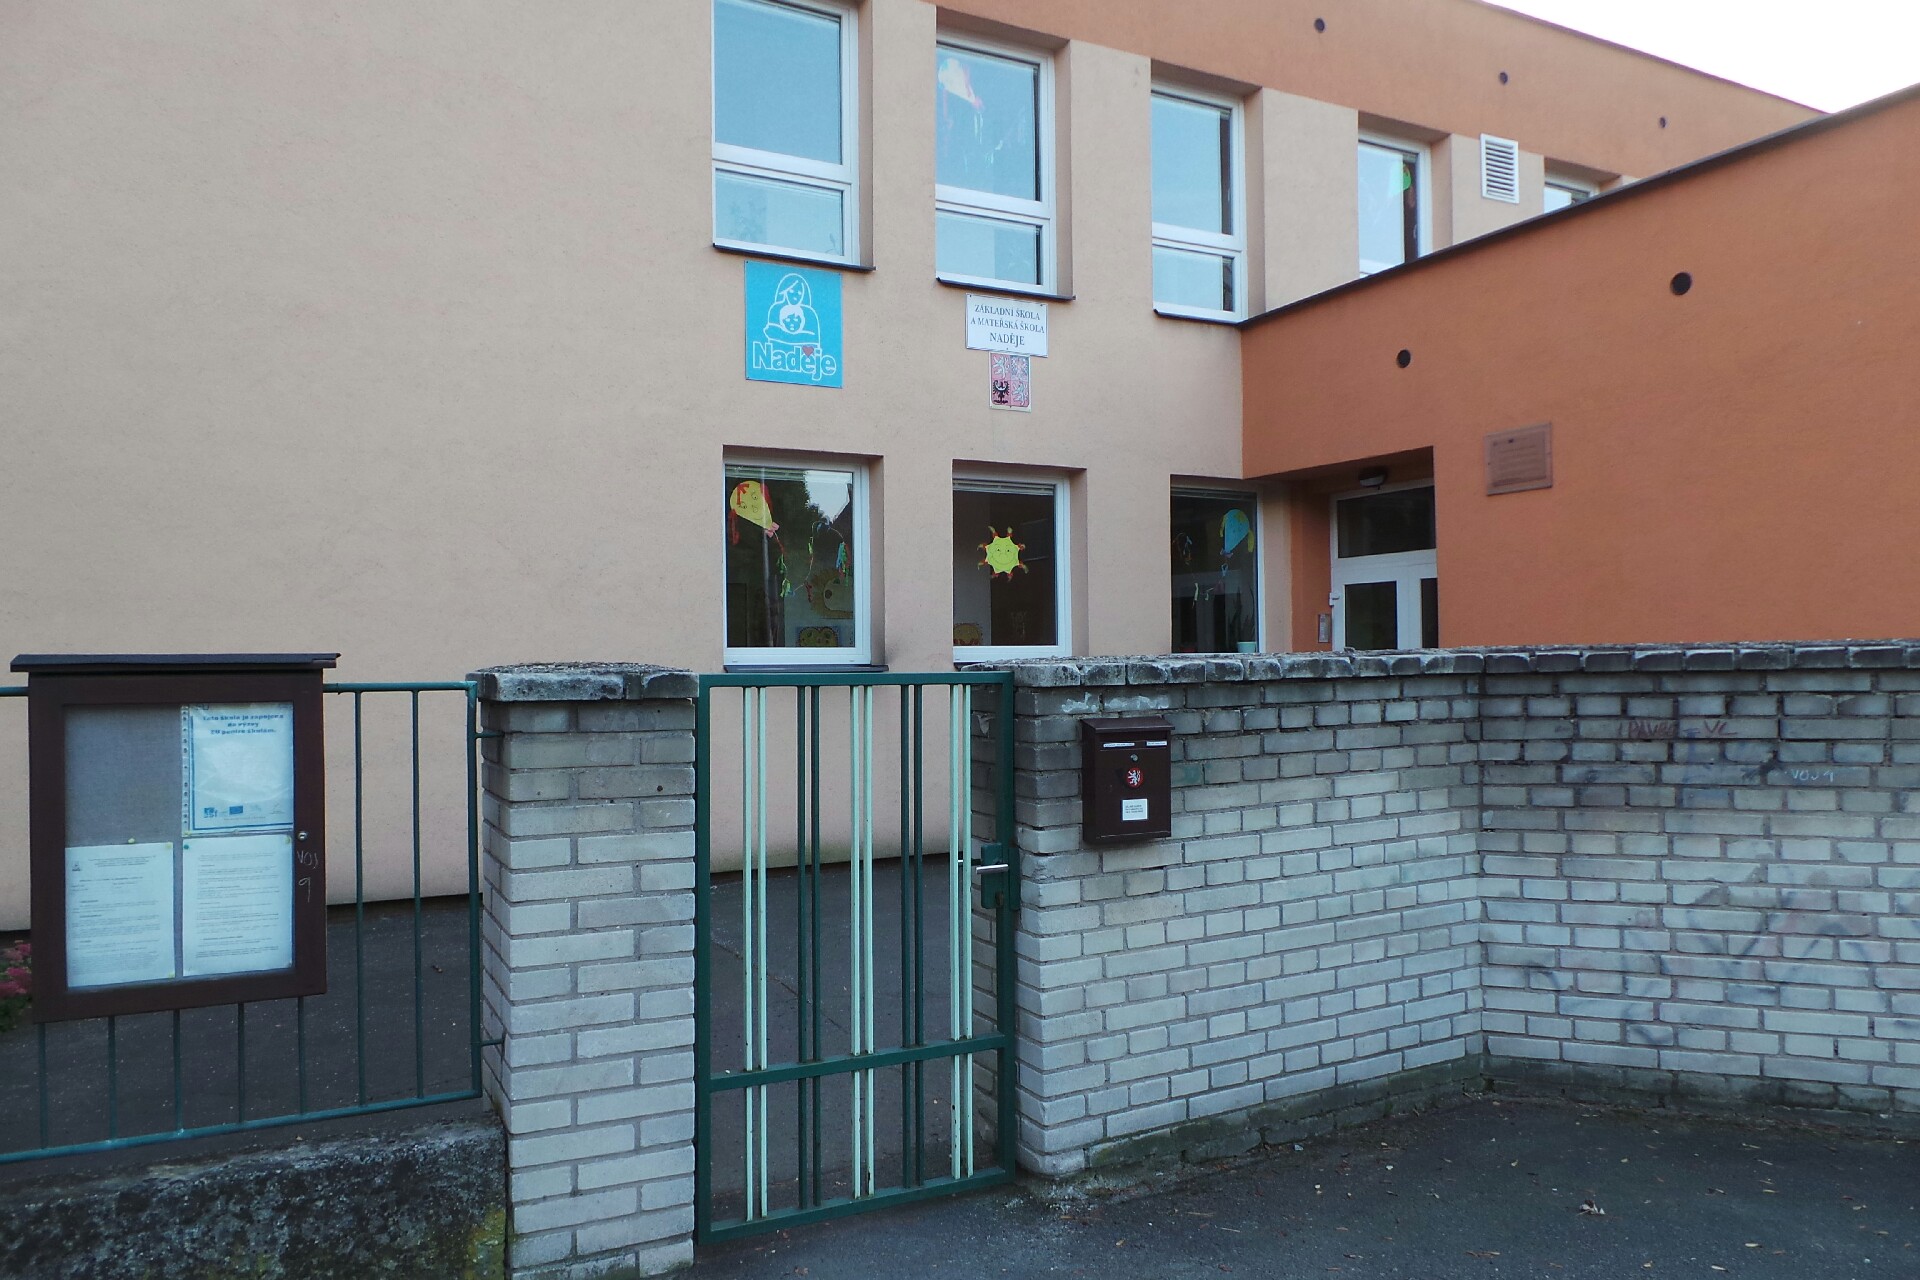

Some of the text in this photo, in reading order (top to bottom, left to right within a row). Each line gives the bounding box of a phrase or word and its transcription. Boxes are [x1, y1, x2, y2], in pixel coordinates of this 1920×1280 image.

[974, 303, 1041, 320] ZÁKLADNÍ ŠKOLA
[970, 317, 1045, 333] A MATEŘSKÁ ŠKOLA
[989, 332, 1025, 348] NADĚJE
